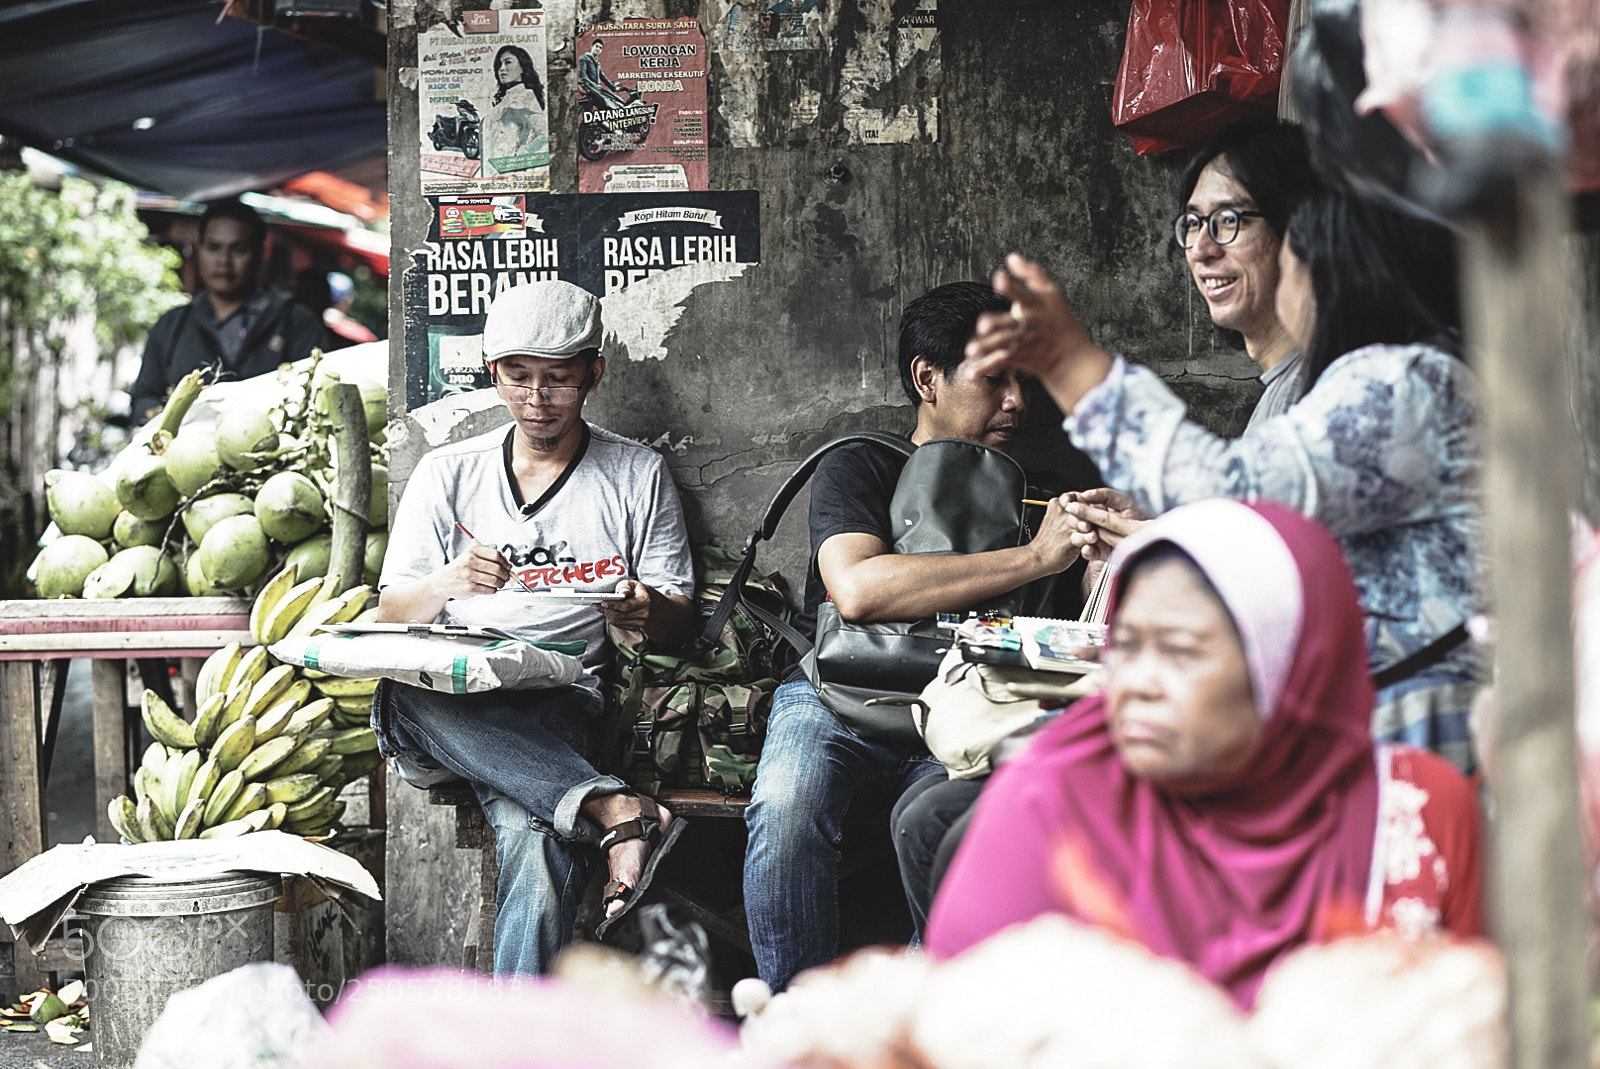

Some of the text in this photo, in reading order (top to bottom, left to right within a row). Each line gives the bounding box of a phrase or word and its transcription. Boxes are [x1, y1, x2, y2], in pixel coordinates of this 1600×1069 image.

[510, 11, 544, 27] NSS
[597, 22, 644, 31] NUSANTARA
[646, 21, 671, 29] SURYA
[673, 21, 697, 29] SAKTI
[441, 35, 487, 46] NUSANTARA
[488, 34, 513, 44] SURYA
[515, 33, 539, 43] SAKTI
[463, 46, 494, 55] HONDA
[622, 44, 697, 57] LOWONGAN
[639, 57, 681, 68] KERJA
[617, 70, 705, 79] MARKETING EKSEKUTIF
[637, 80, 684, 92] HONDA
[583, 108, 624, 124] DATANG
[625, 106, 656, 118] LANGSUNG
[608, 115, 648, 131] INTERVIEW
[634, 212, 654, 222] Kopi
[656, 210, 681, 219] Hitam
[427, 238, 559, 271] RASA LEBIH
[603, 235, 737, 267] RASA LEBIH
